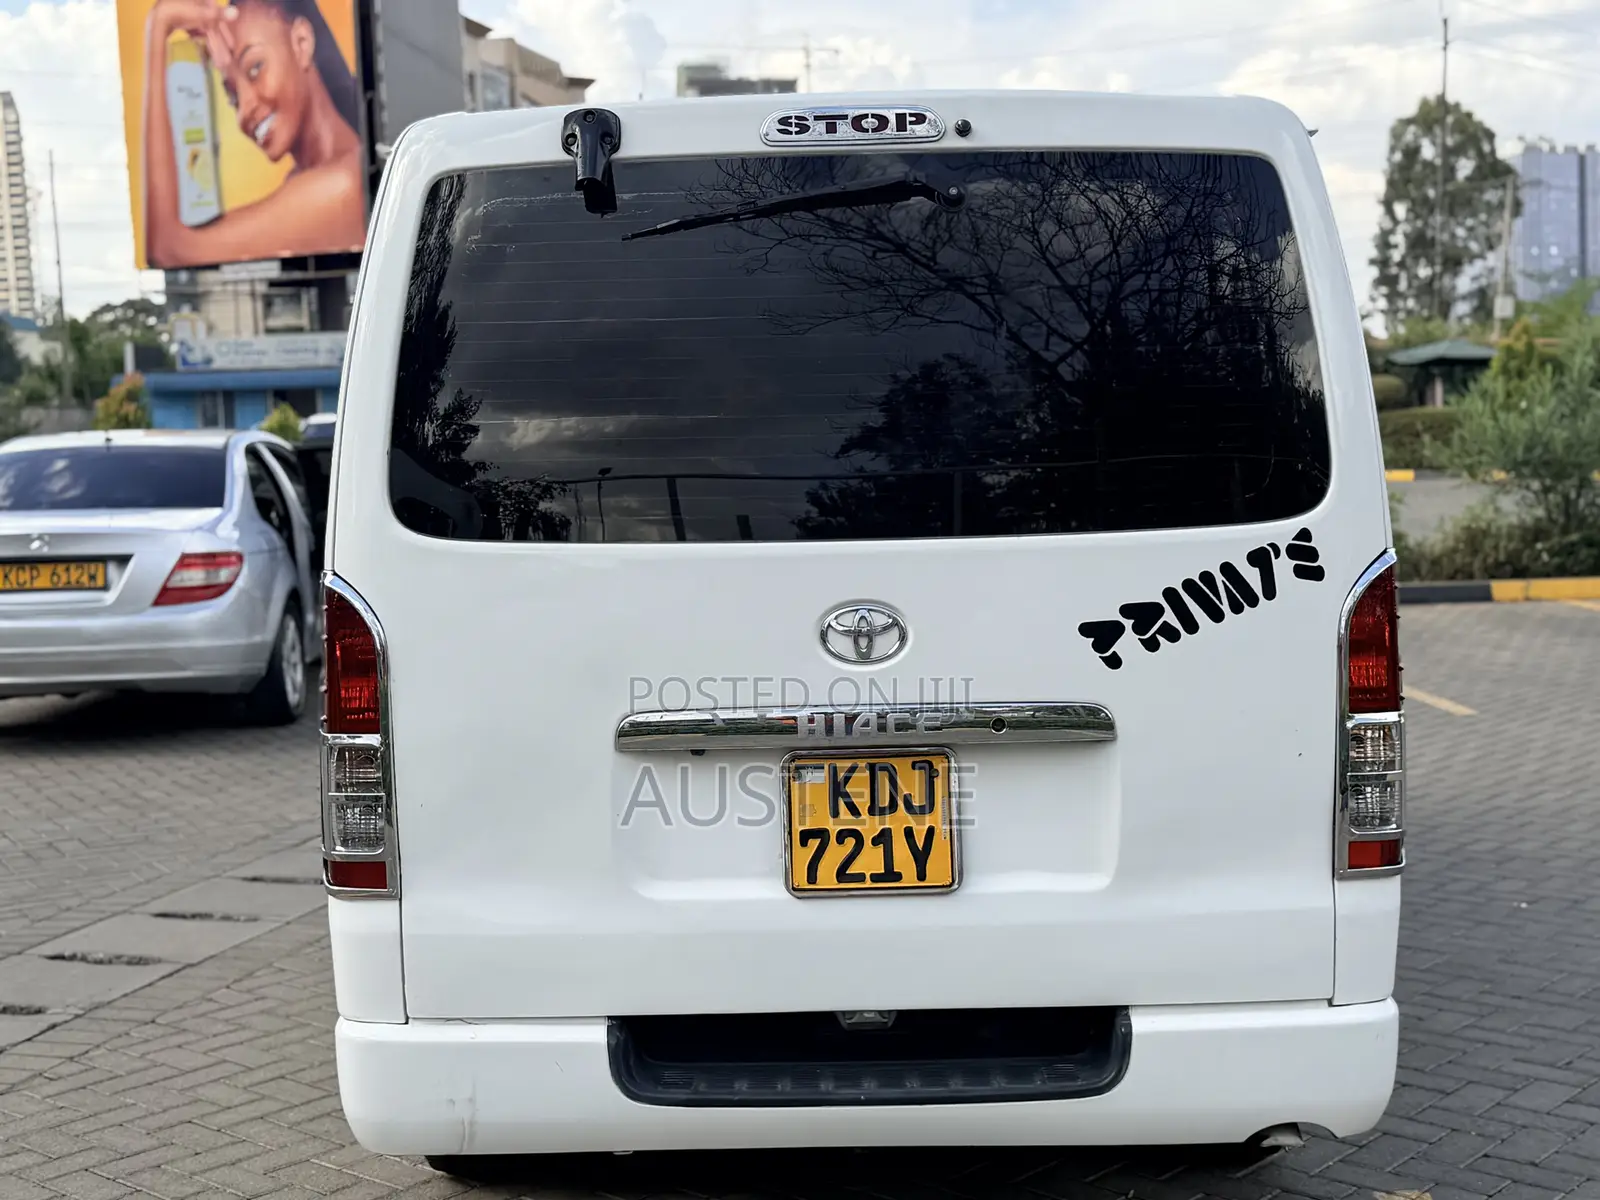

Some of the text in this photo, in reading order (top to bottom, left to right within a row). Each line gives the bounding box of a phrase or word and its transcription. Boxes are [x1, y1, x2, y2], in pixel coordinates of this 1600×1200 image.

[776, 112, 928, 136] STOP
[2, 562, 98, 588] KCP 612W
[798, 711, 944, 738] HIACE
[828, 760, 936, 819] KDJ
[799, 826, 936, 885] 721Y
